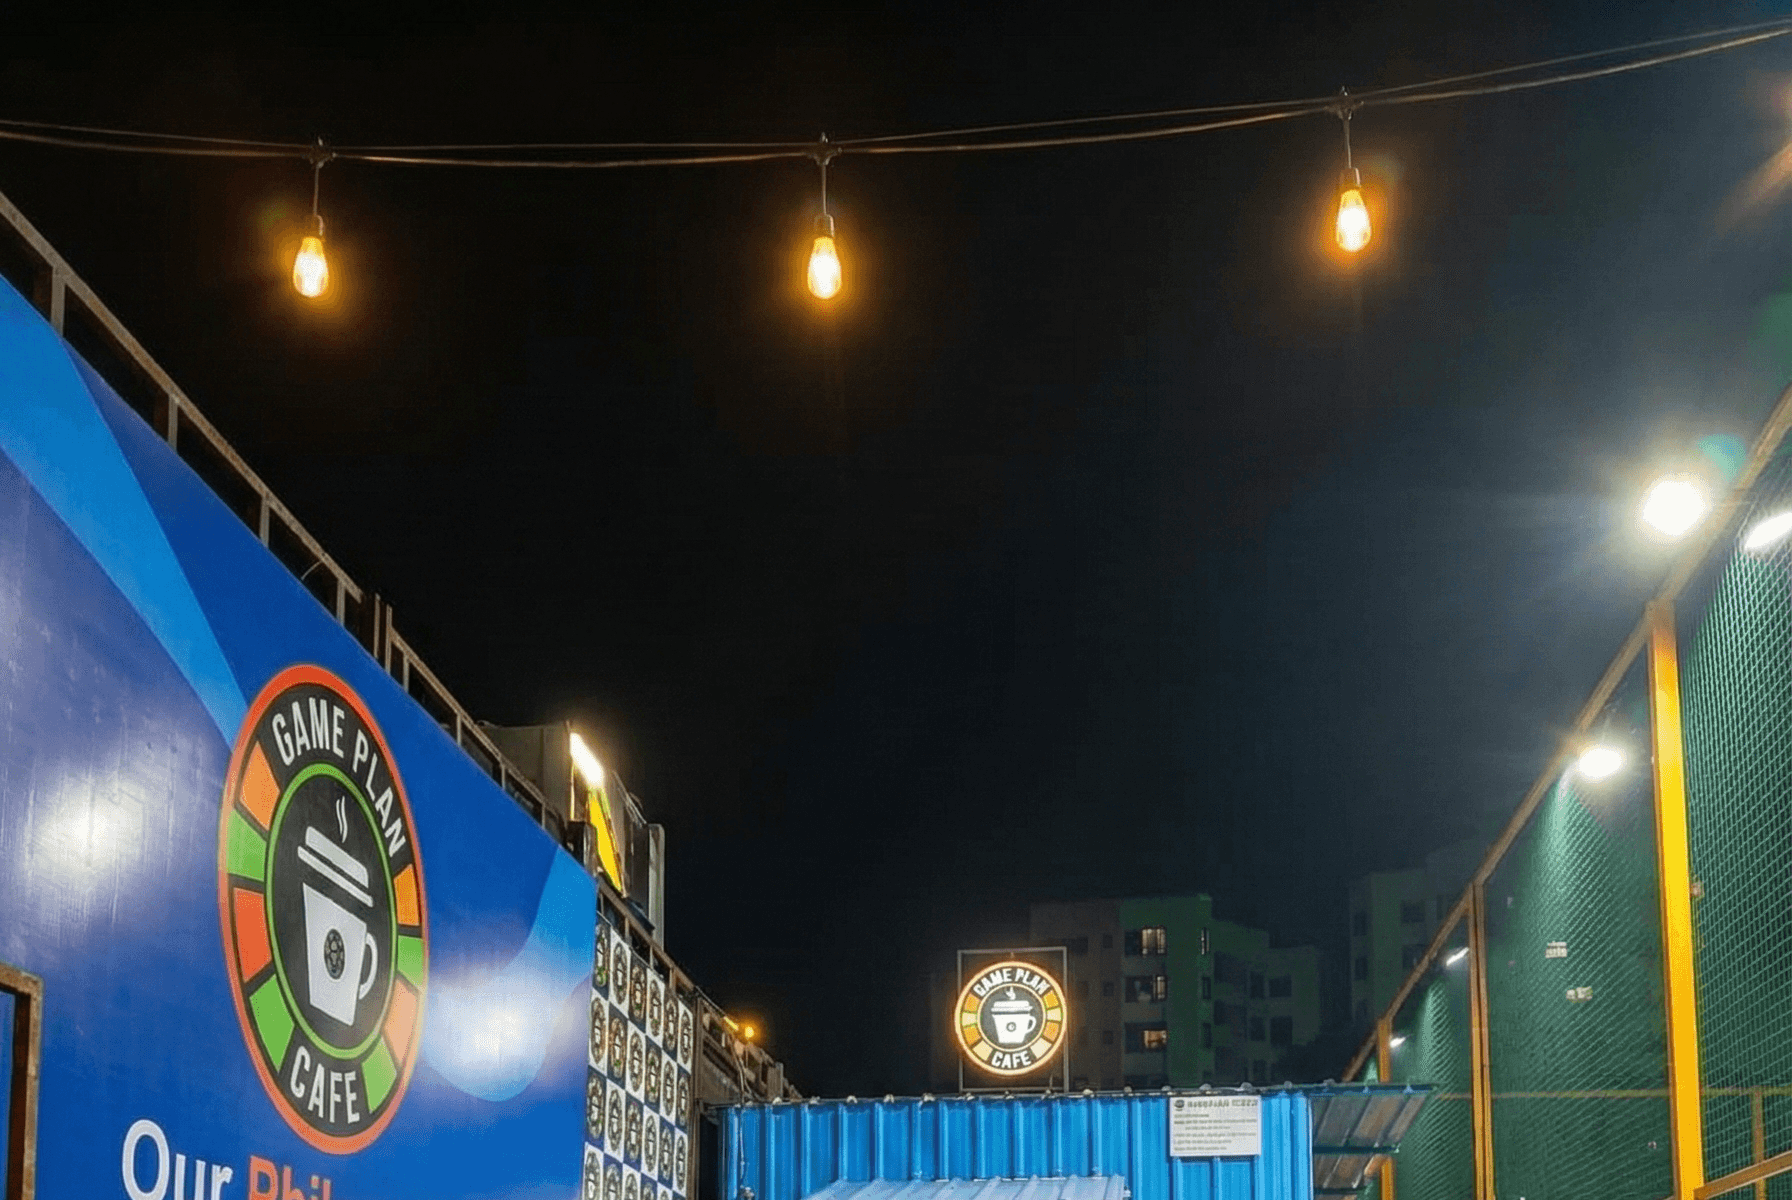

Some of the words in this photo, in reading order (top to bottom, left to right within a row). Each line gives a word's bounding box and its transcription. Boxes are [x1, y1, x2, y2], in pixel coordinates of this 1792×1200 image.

[271, 697, 346, 766] GAME
[354, 729, 406, 858] PLAN
[289, 1046, 361, 1124] CAFE
[991, 1050, 1031, 1069] CAFE
